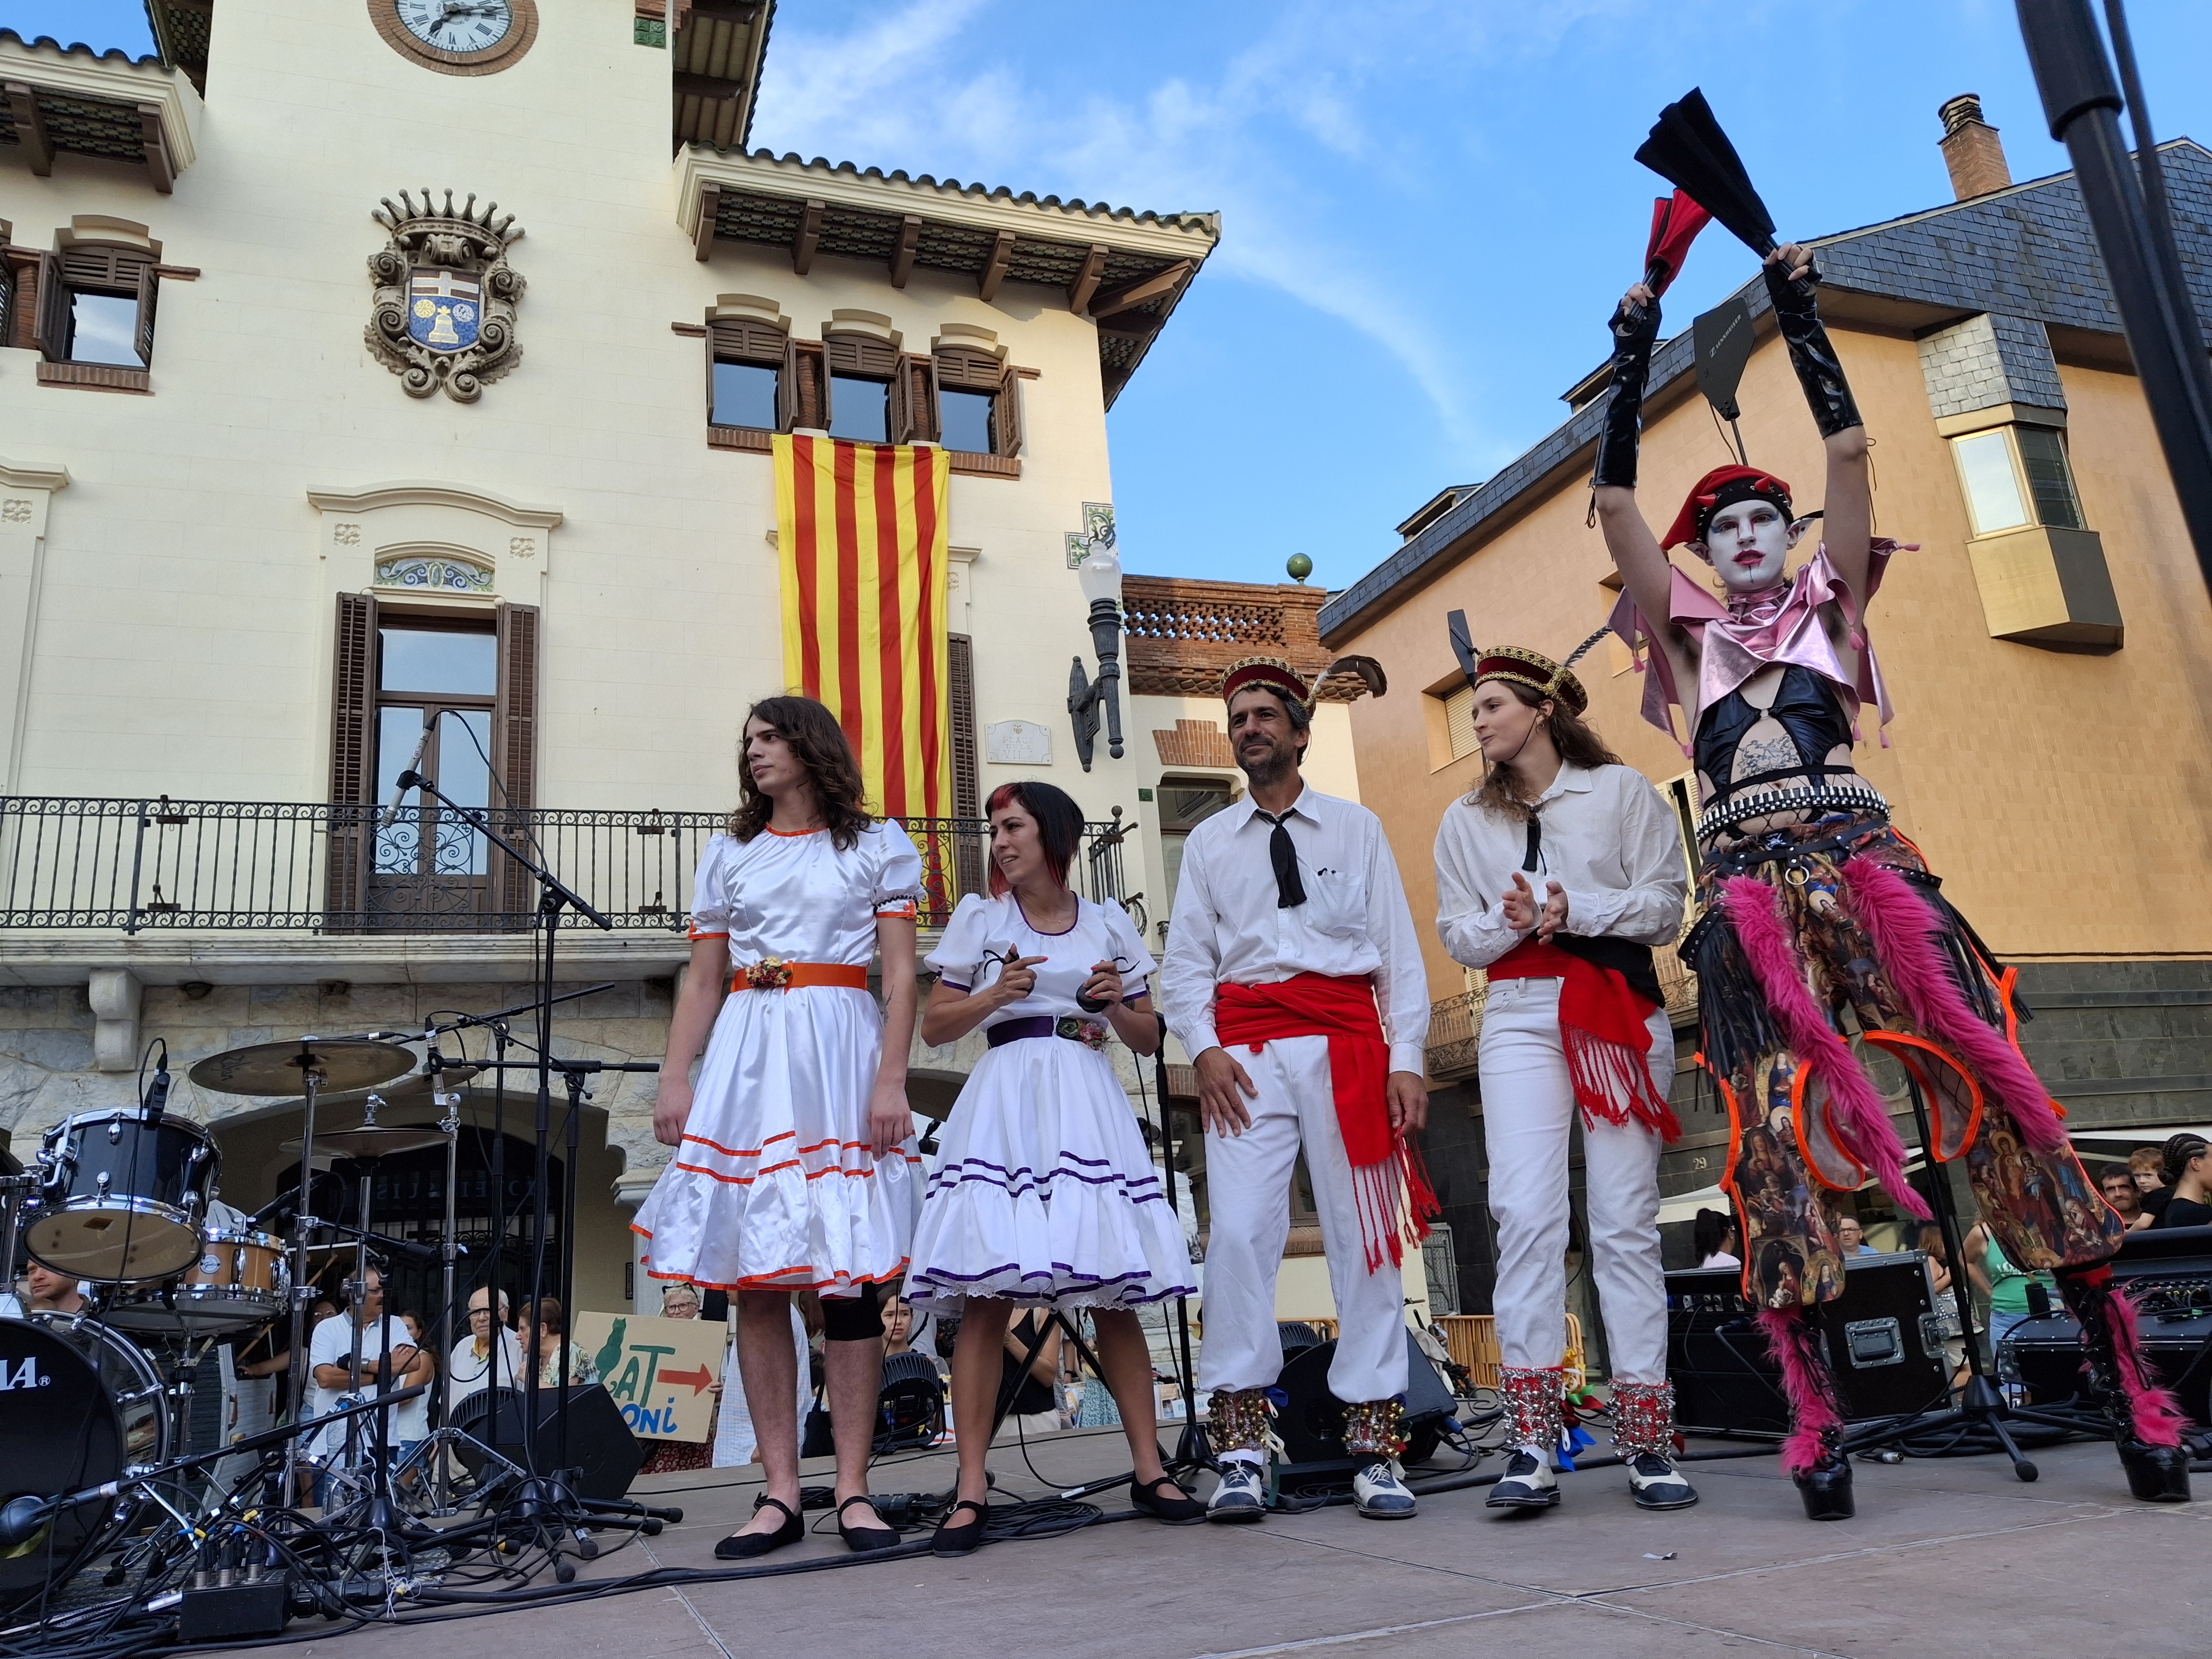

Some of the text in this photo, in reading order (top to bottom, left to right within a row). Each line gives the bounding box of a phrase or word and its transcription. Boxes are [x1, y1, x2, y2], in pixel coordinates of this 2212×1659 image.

[481, 12, 497, 21] III
[474, 22, 493, 36] IIII
[1715, 314, 1741, 350] SENNHEISER
[1002, 749, 1036, 760] VILA
[1693, 1156, 1707, 1171] 29
